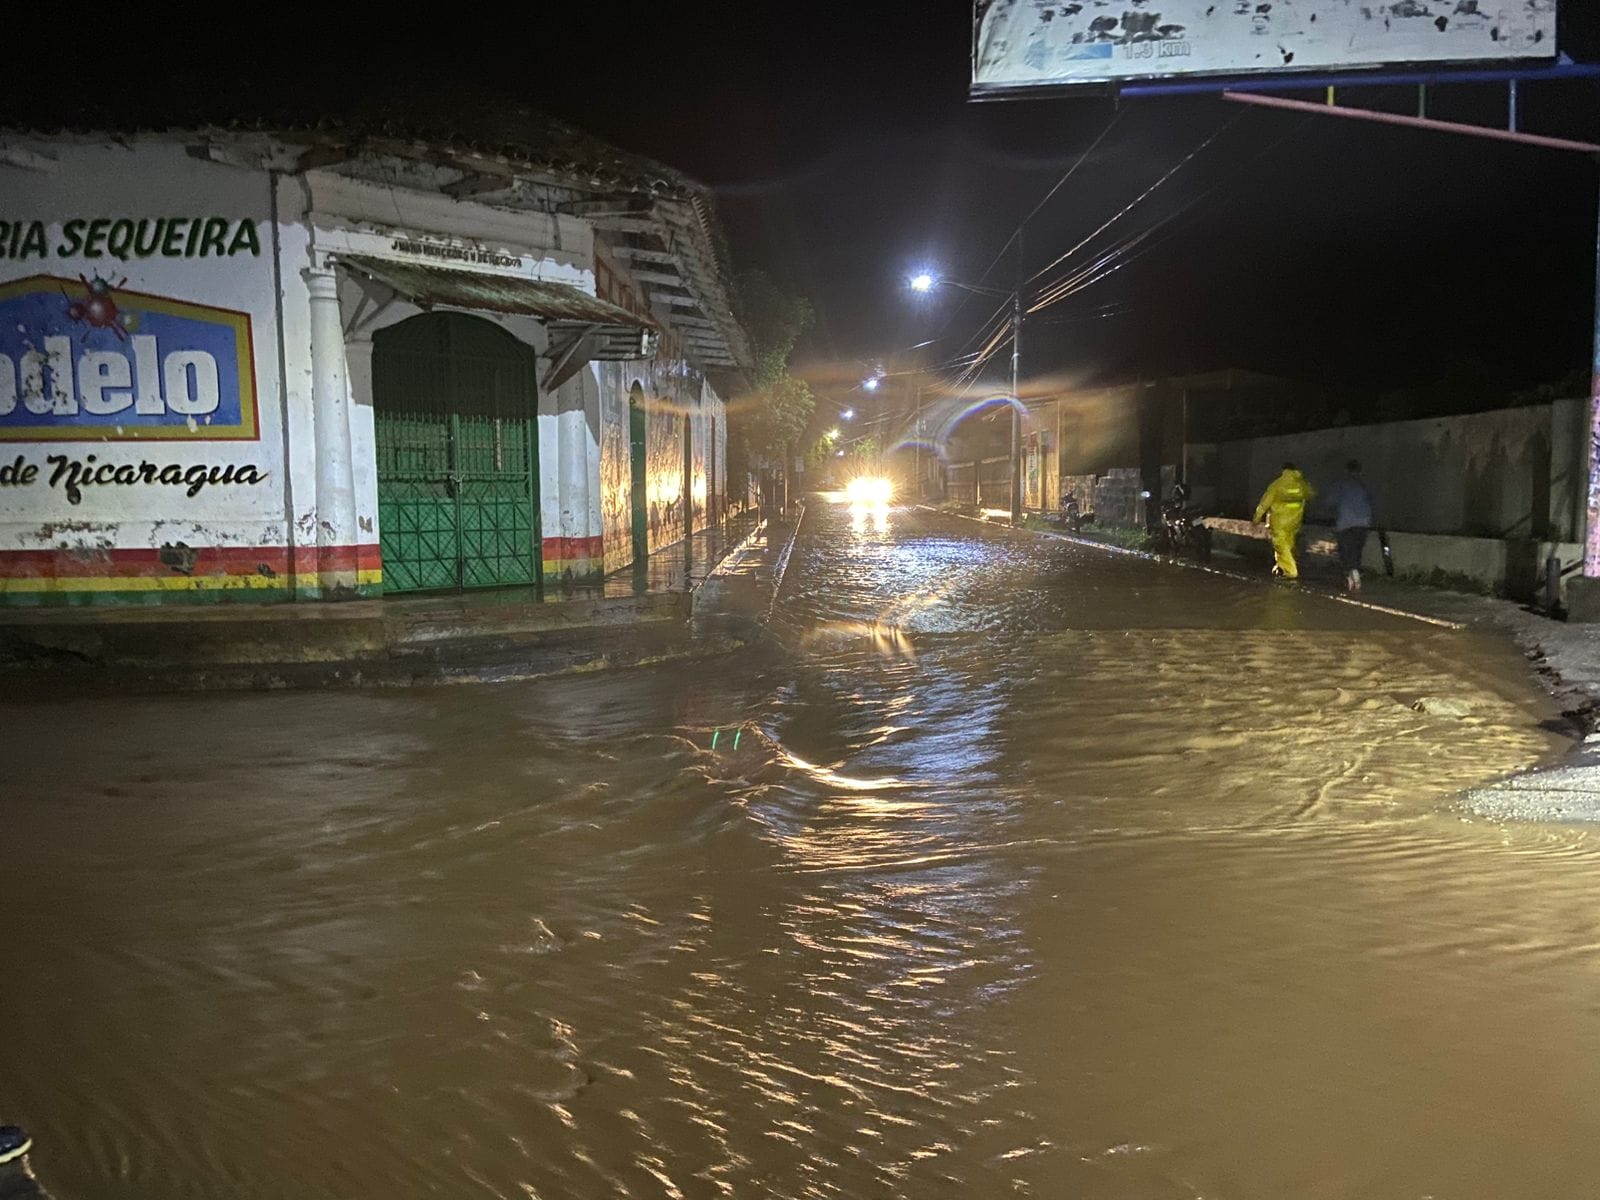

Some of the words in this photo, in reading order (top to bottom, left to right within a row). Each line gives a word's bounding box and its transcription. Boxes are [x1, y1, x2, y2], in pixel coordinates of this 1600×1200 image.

[1158, 39, 1191, 58] km
[57, 218, 260, 260] SEQUEIRA
[0, 455, 39, 487] de
[47, 454, 268, 500] Nicaragua
